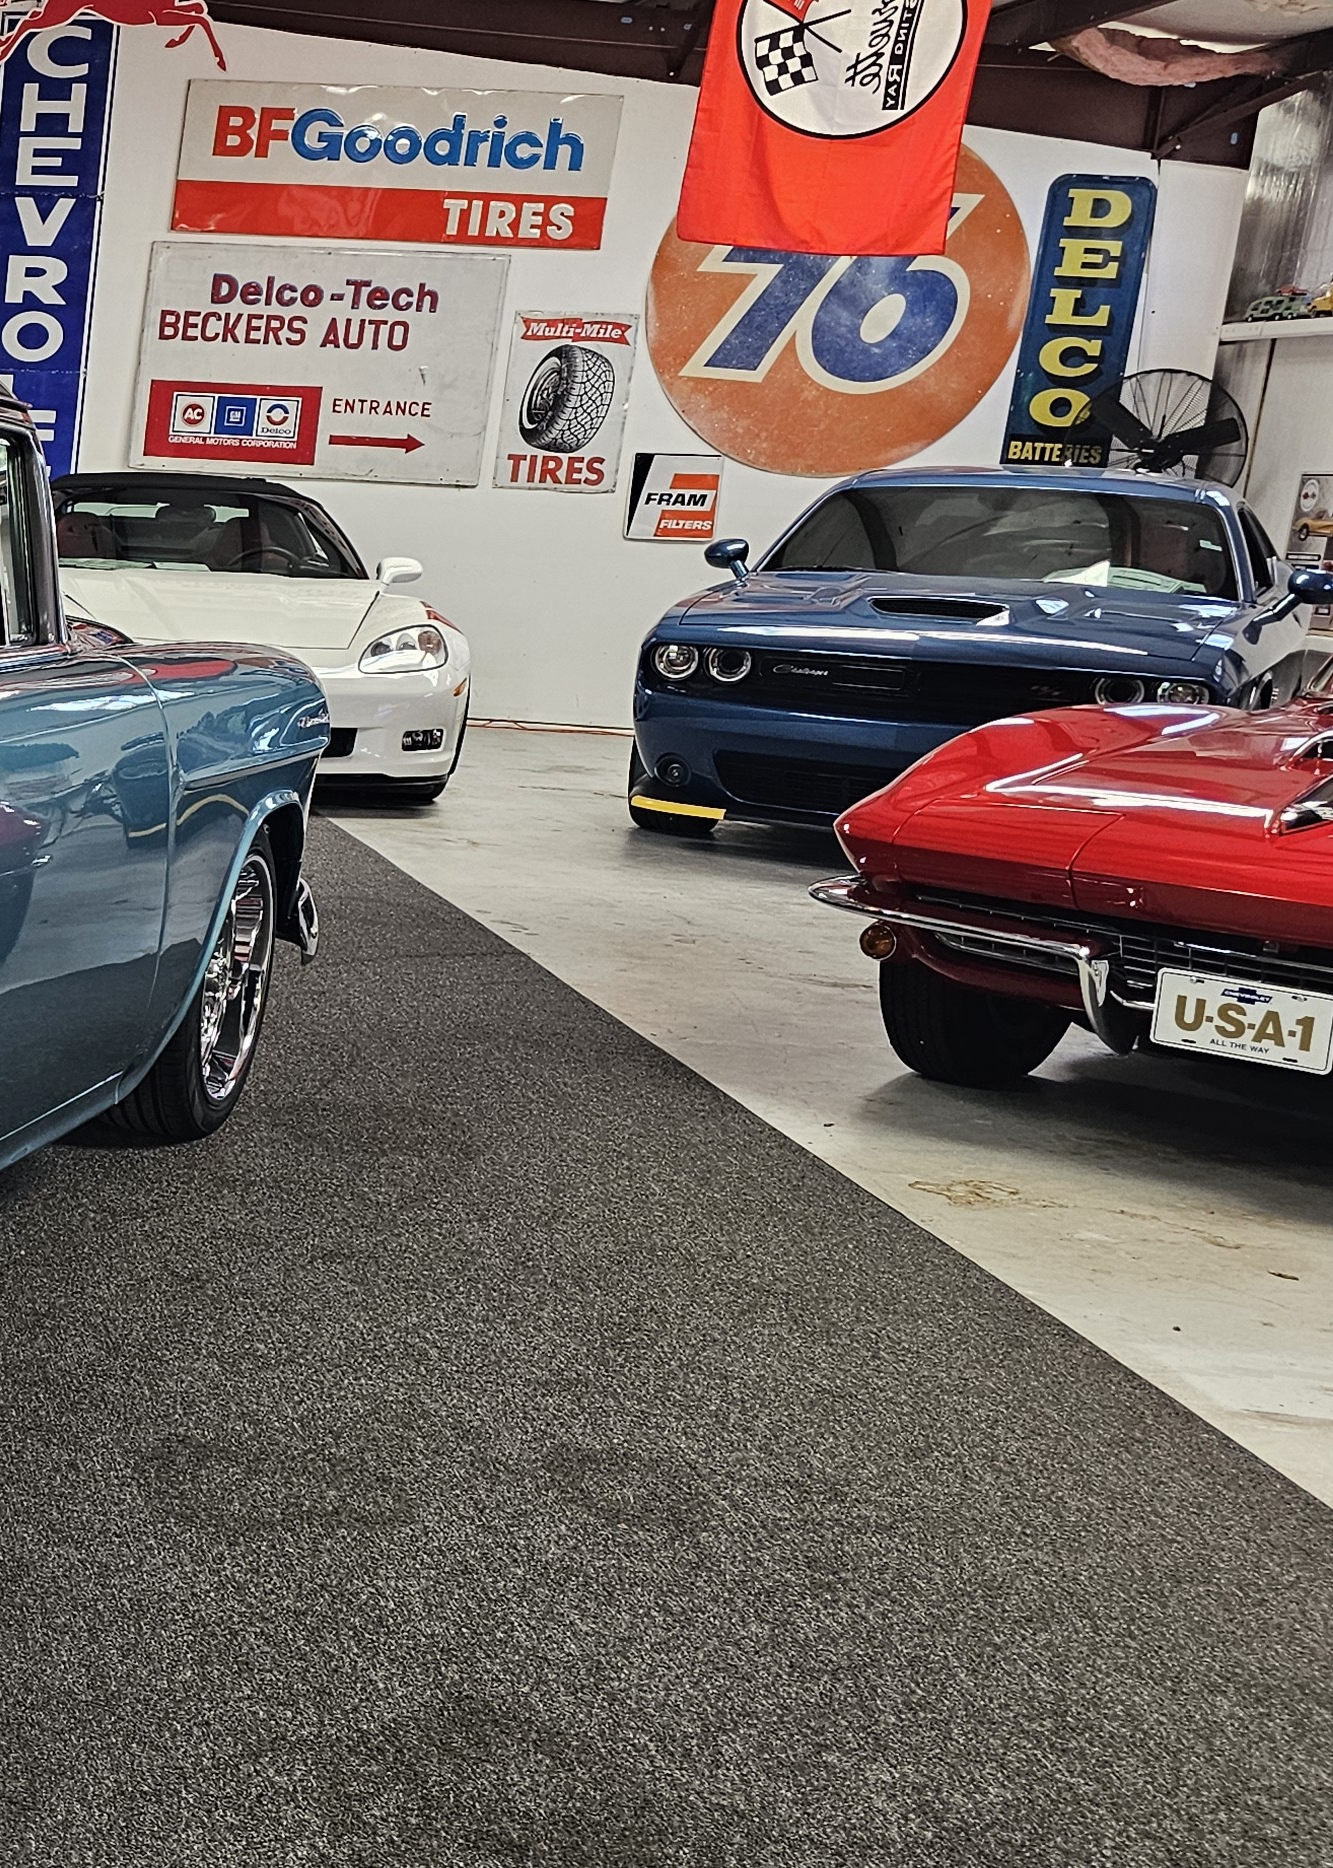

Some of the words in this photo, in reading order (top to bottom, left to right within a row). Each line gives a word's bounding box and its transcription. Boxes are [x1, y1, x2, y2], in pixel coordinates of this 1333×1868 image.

[212, 104, 585, 171] BFGoodrich
[442, 198, 575, 240] TIRES
[210, 272, 439, 313] Delco-Tech
[678, 192, 985, 395] 76
[1028, 188, 1133, 428] DELCO
[158, 309, 308, 346] BECKERS
[319, 316, 411, 351] AUTO
[525, 322, 623, 339] Multi-Mile
[184, 407, 203, 420] AC
[332, 398, 432, 418] ENTRANCE
[260, 427, 292, 435] Delco
[168, 435, 205, 445] GENERAL
[206, 437, 241, 447] MOTORS
[241, 439, 297, 449] CORPORATION
[1007, 440, 1102, 465] BATTERIES
[507, 453, 606, 487] TIRES
[644, 492, 708, 507] FRAM
[659, 519, 712, 531] FILTERS
[1224, 989, 1271, 1002] CHEVROLET
[1210, 1038, 1227, 1047] ALL
[1229, 1042, 1247, 1050] THE
[1250, 1045, 1270, 1055] WAY
